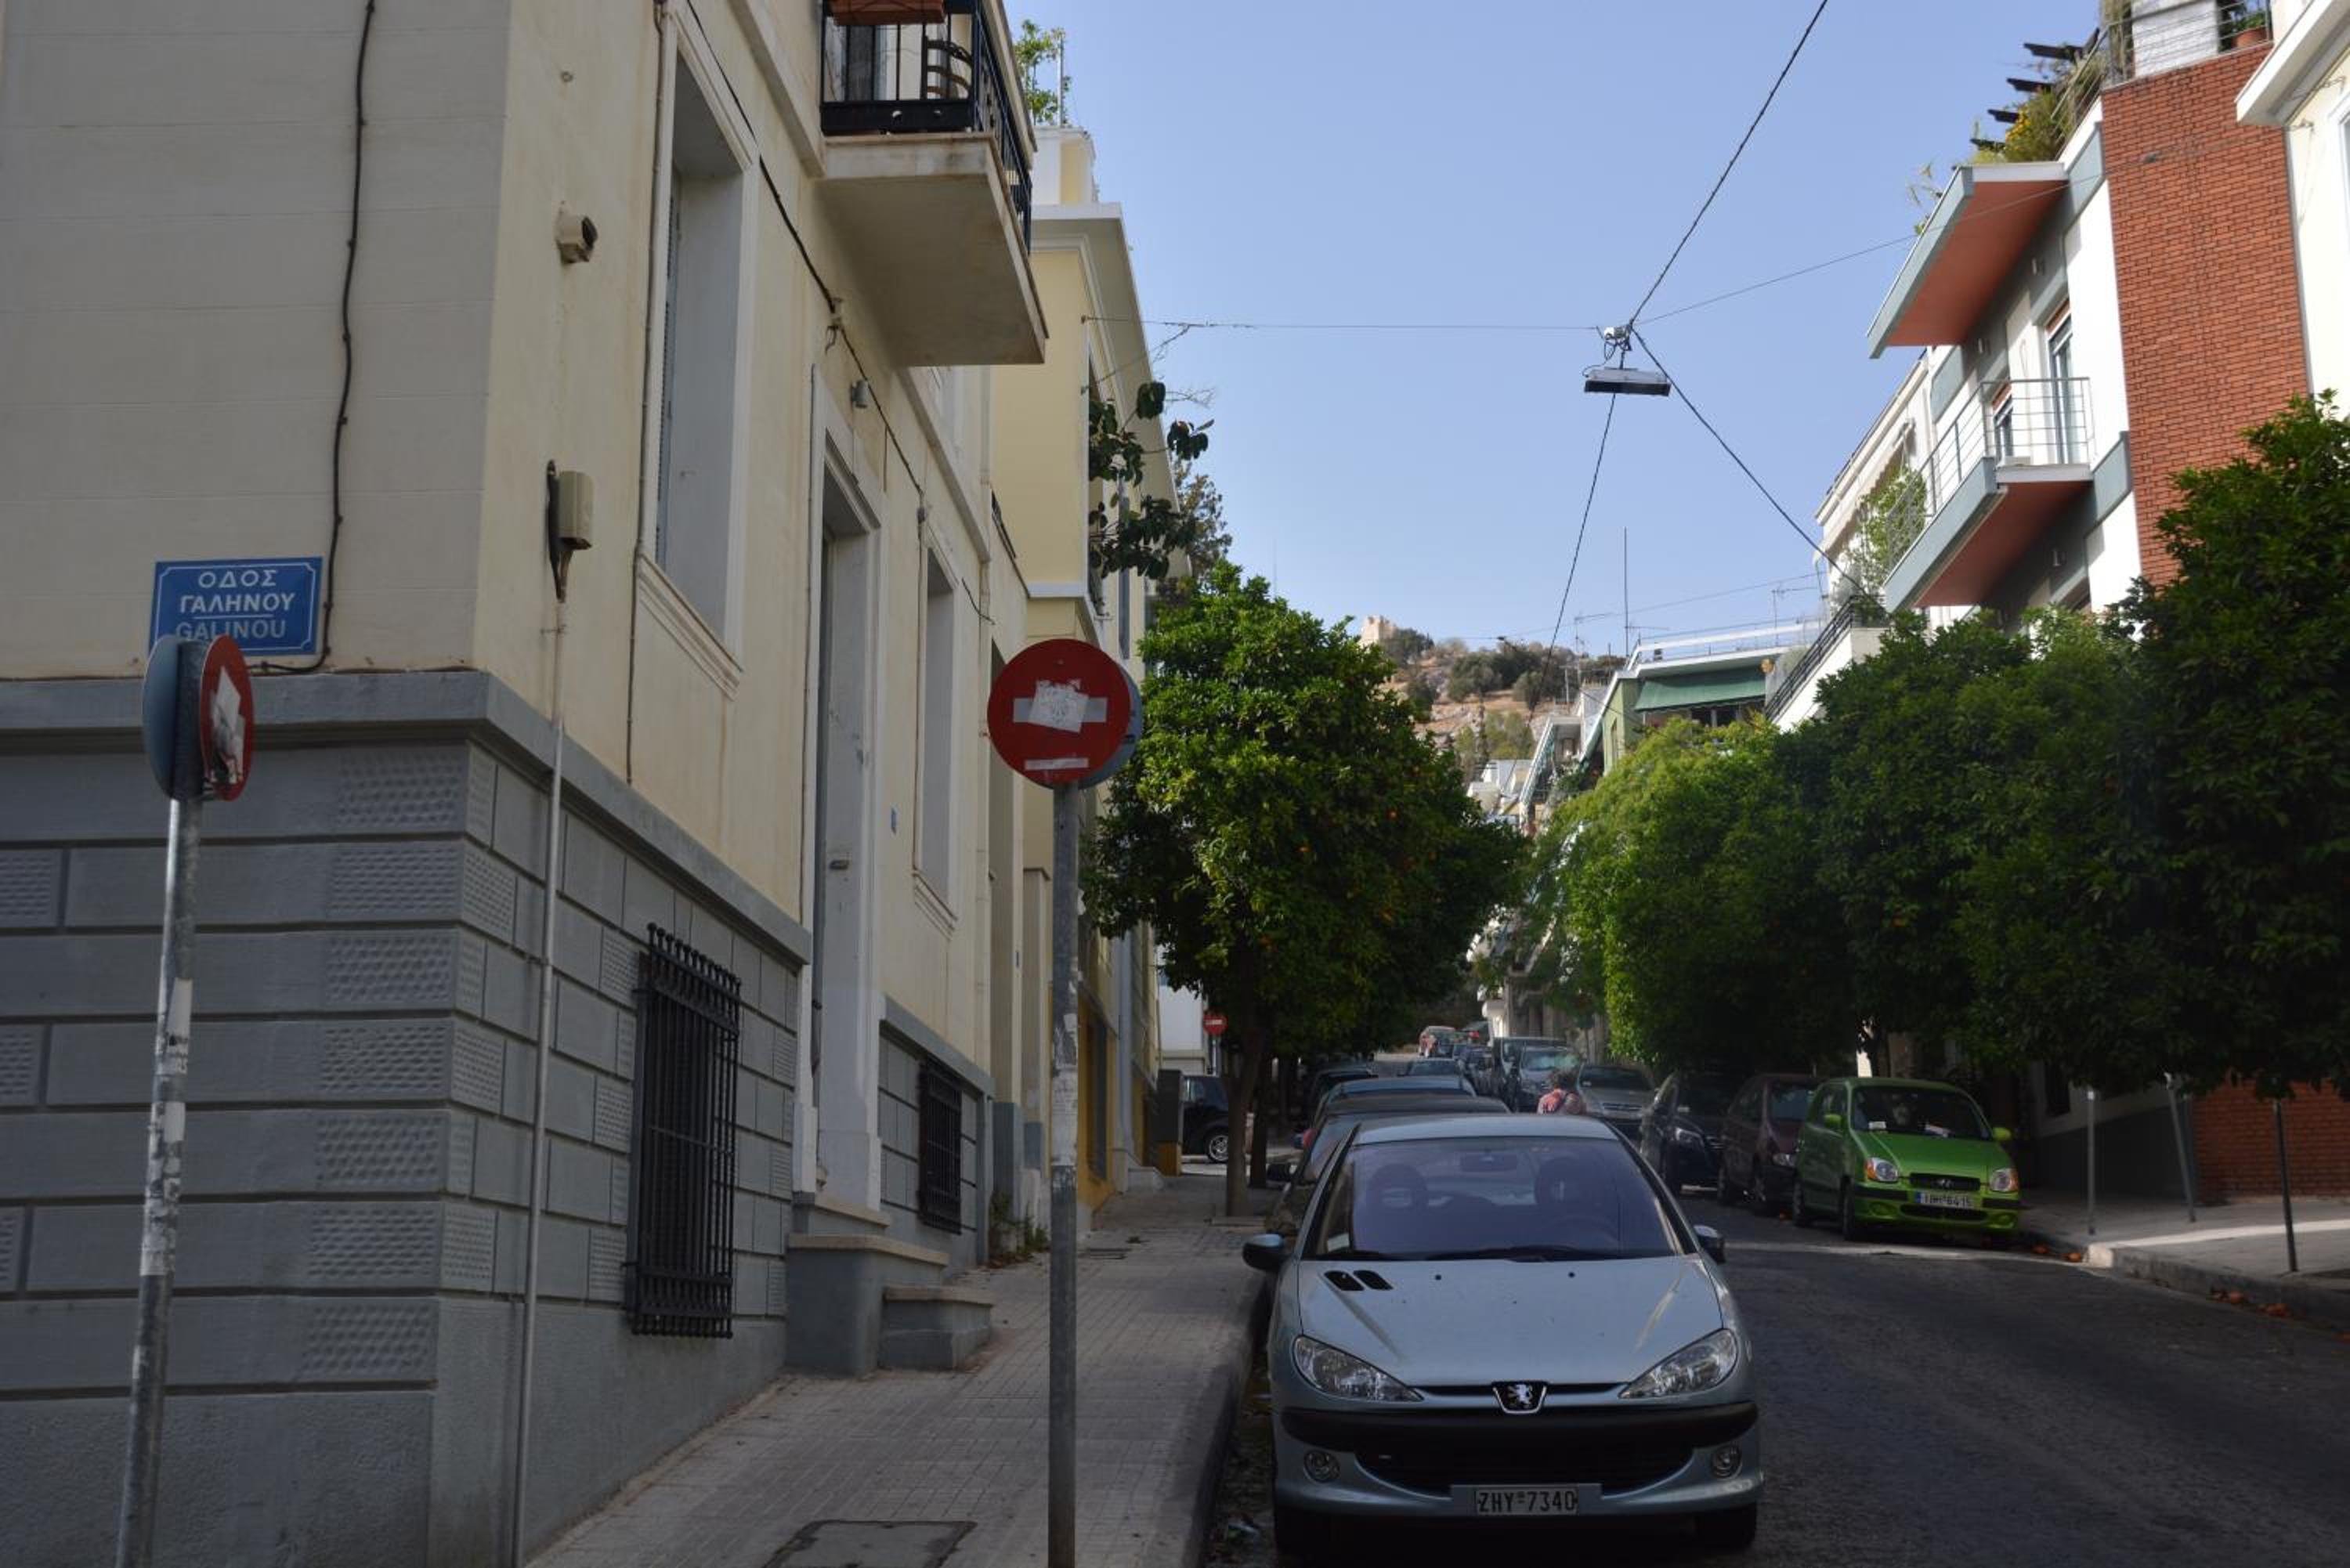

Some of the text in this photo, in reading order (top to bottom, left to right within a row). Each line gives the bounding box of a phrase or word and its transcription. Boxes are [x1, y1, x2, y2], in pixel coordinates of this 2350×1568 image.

[198, 569, 277, 588] ΟΔΟΣ
[180, 592, 295, 613] ΓΑΛΗΝΟΥ
[175, 619, 287, 641] GALINOU
